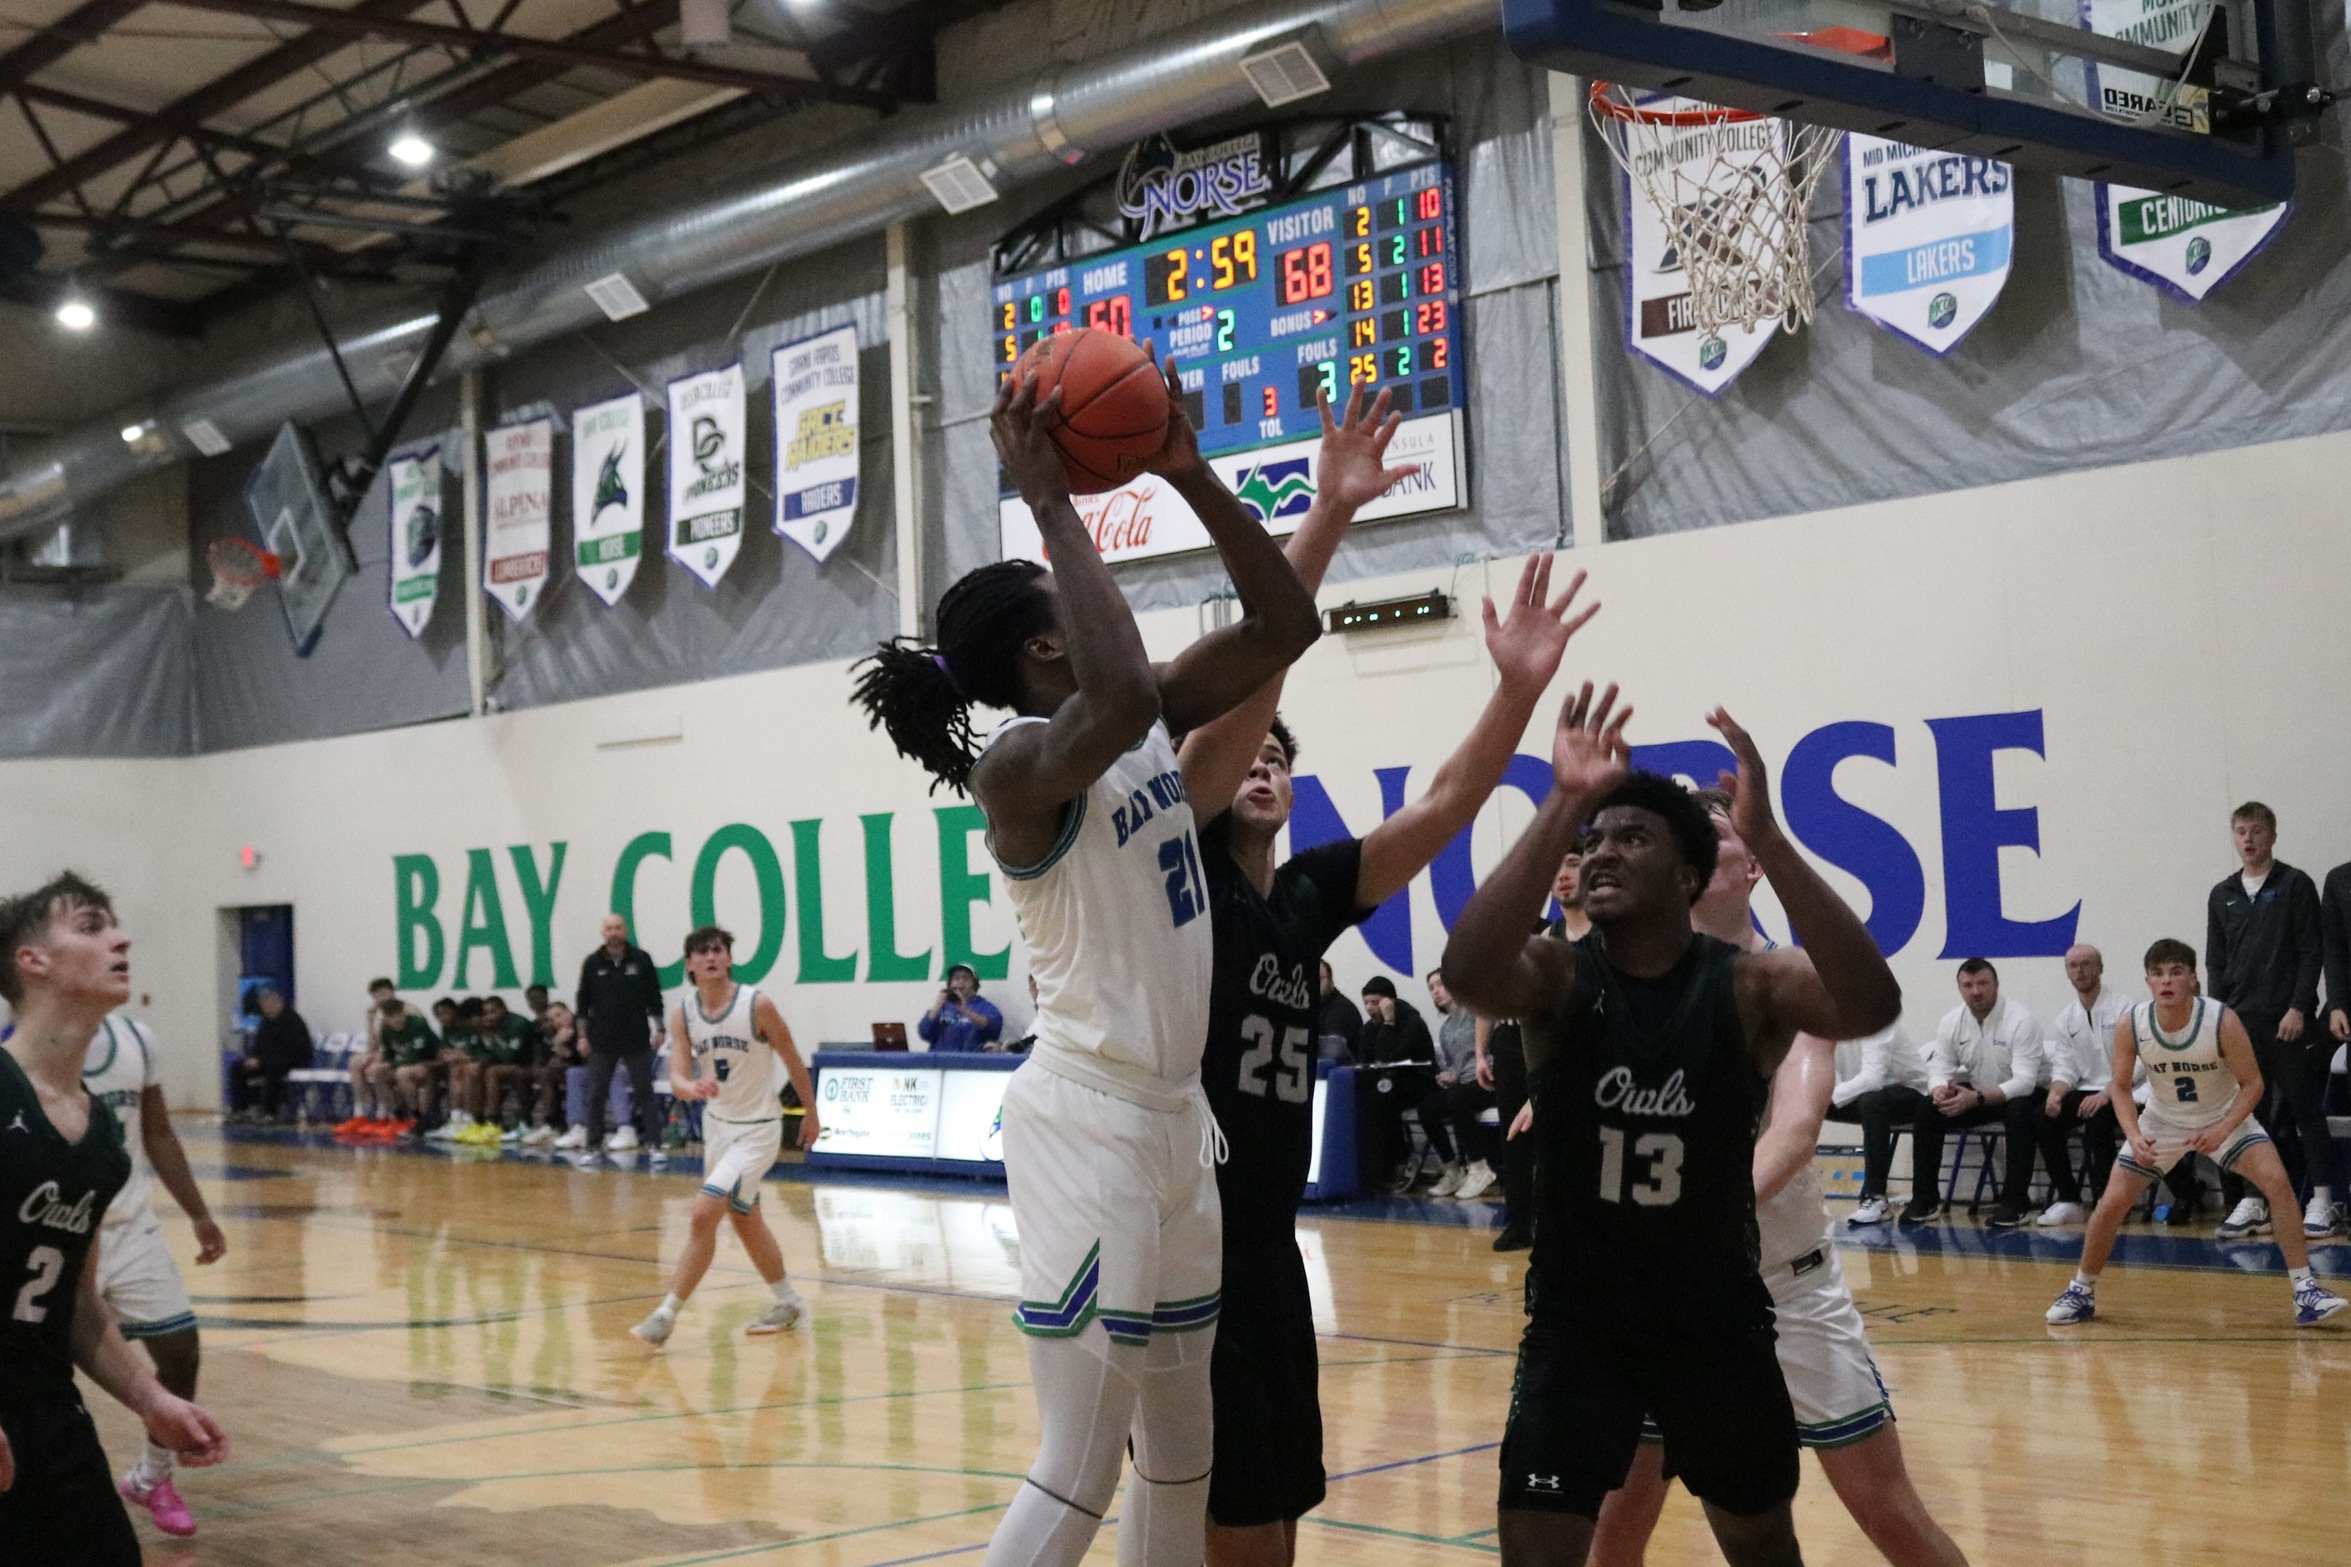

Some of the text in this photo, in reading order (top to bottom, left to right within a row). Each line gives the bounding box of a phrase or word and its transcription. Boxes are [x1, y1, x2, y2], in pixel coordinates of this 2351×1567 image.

[1635, 124, 1773, 177] COMMUNITY COLLEGE
[1863, 148, 1883, 168] MID
[1122, 148, 1267, 240] NORSE
[1348, 185, 1366, 207] NO
[1410, 165, 1435, 190] PTS
[1864, 156, 2009, 224] LAKERS
[1267, 207, 1334, 245] VISITOR
[1357, 187, 1441, 237] 2 1 10
[1167, 229, 1257, 301] 2:59
[1358, 225, 1443, 274] 5 2 11
[1906, 238, 1975, 285] LAKERS
[1046, 268, 1068, 289] PTS
[1083, 262, 1127, 295] HOME
[1284, 242, 1332, 303] 68
[1353, 262, 1445, 311] 13 1 13
[1004, 287, 1070, 330] 2 0 0
[1217, 309, 1235, 351] 2
[1270, 311, 1312, 337] BONUS
[1355, 299, 1446, 348] 14 1 23
[1005, 335, 1017, 362] 5
[1170, 322, 1212, 349] PERIOD
[1298, 338, 1337, 364] FOULS
[1222, 356, 1260, 382] FOULS
[1318, 360, 1337, 403] 3
[1349, 337, 1447, 386] 25 2 2
[1263, 386, 1277, 417] 3
[1259, 418, 1283, 439] TOL
[801, 482, 842, 514] RAIDERS
[690, 511, 734, 541] PIONEERS
[1111, 788, 1154, 849] BAY
[392, 842, 568, 991] BAY
[610, 804, 1018, 992] COLLE
[1157, 828, 1206, 928] 21
[1250, 952, 1310, 1010] Owls
[712, 1035, 749, 1053] NORSE
[1238, 1013, 1310, 1104] 25
[840, 1077, 873, 1090] FIRST
[904, 1077, 918, 1092] NK
[2171, 1061, 2218, 1073] NORSE
[840, 1090, 870, 1103] BANK
[1594, 1065, 1696, 1117] Owls
[2174, 1076, 2198, 1102] 2
[1598, 1124, 1685, 1208] 13
[18, 1180, 97, 1235] Owls
[11, 1245, 65, 1324] 2
